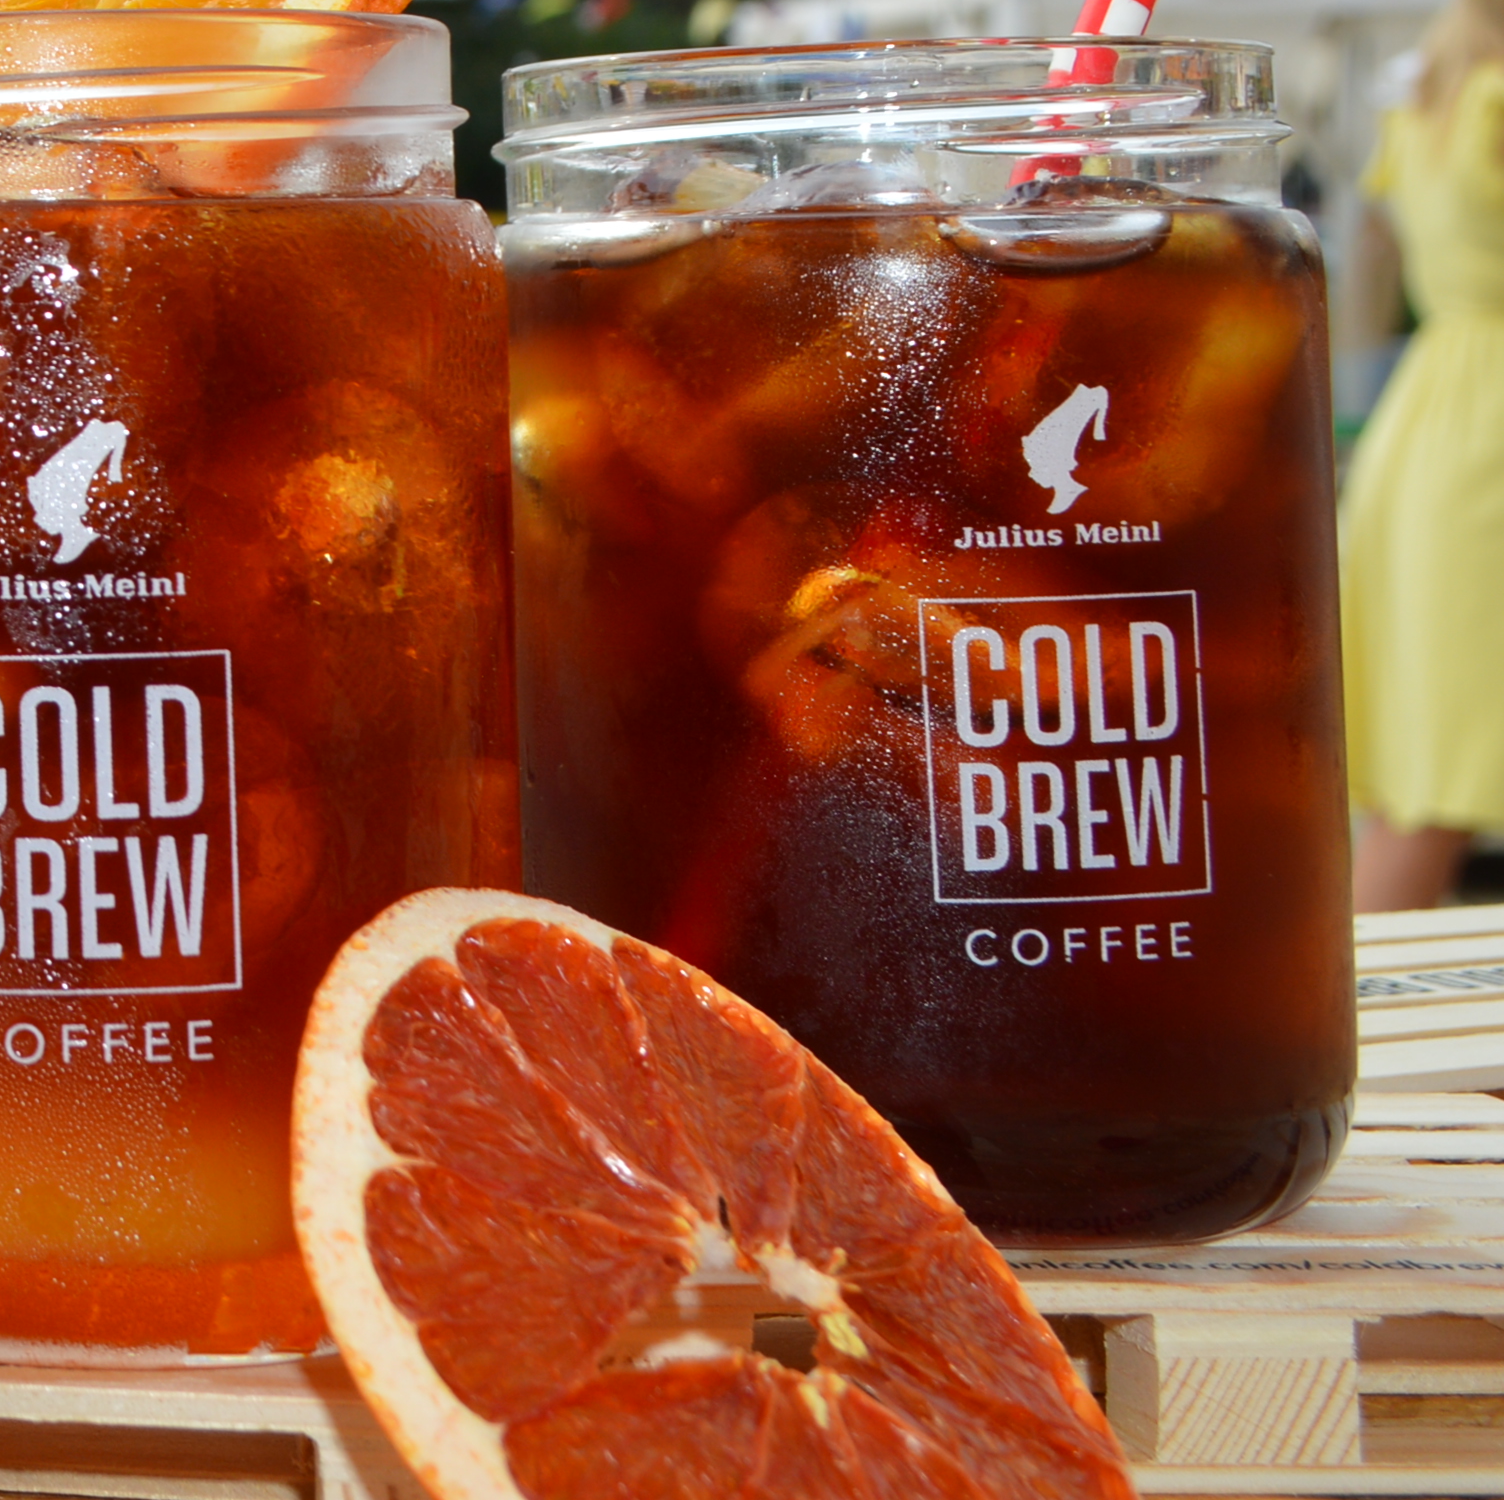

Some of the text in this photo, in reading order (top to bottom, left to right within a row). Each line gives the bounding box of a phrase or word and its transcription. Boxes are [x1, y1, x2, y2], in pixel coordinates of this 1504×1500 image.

[954, 520, 1162, 549] Julius Meinl
[84, 571, 187, 598] Meinl
[952, 621, 1179, 748] COLD
[958, 755, 1183, 871] BREW
[965, 921, 1193, 967] COFFEE
